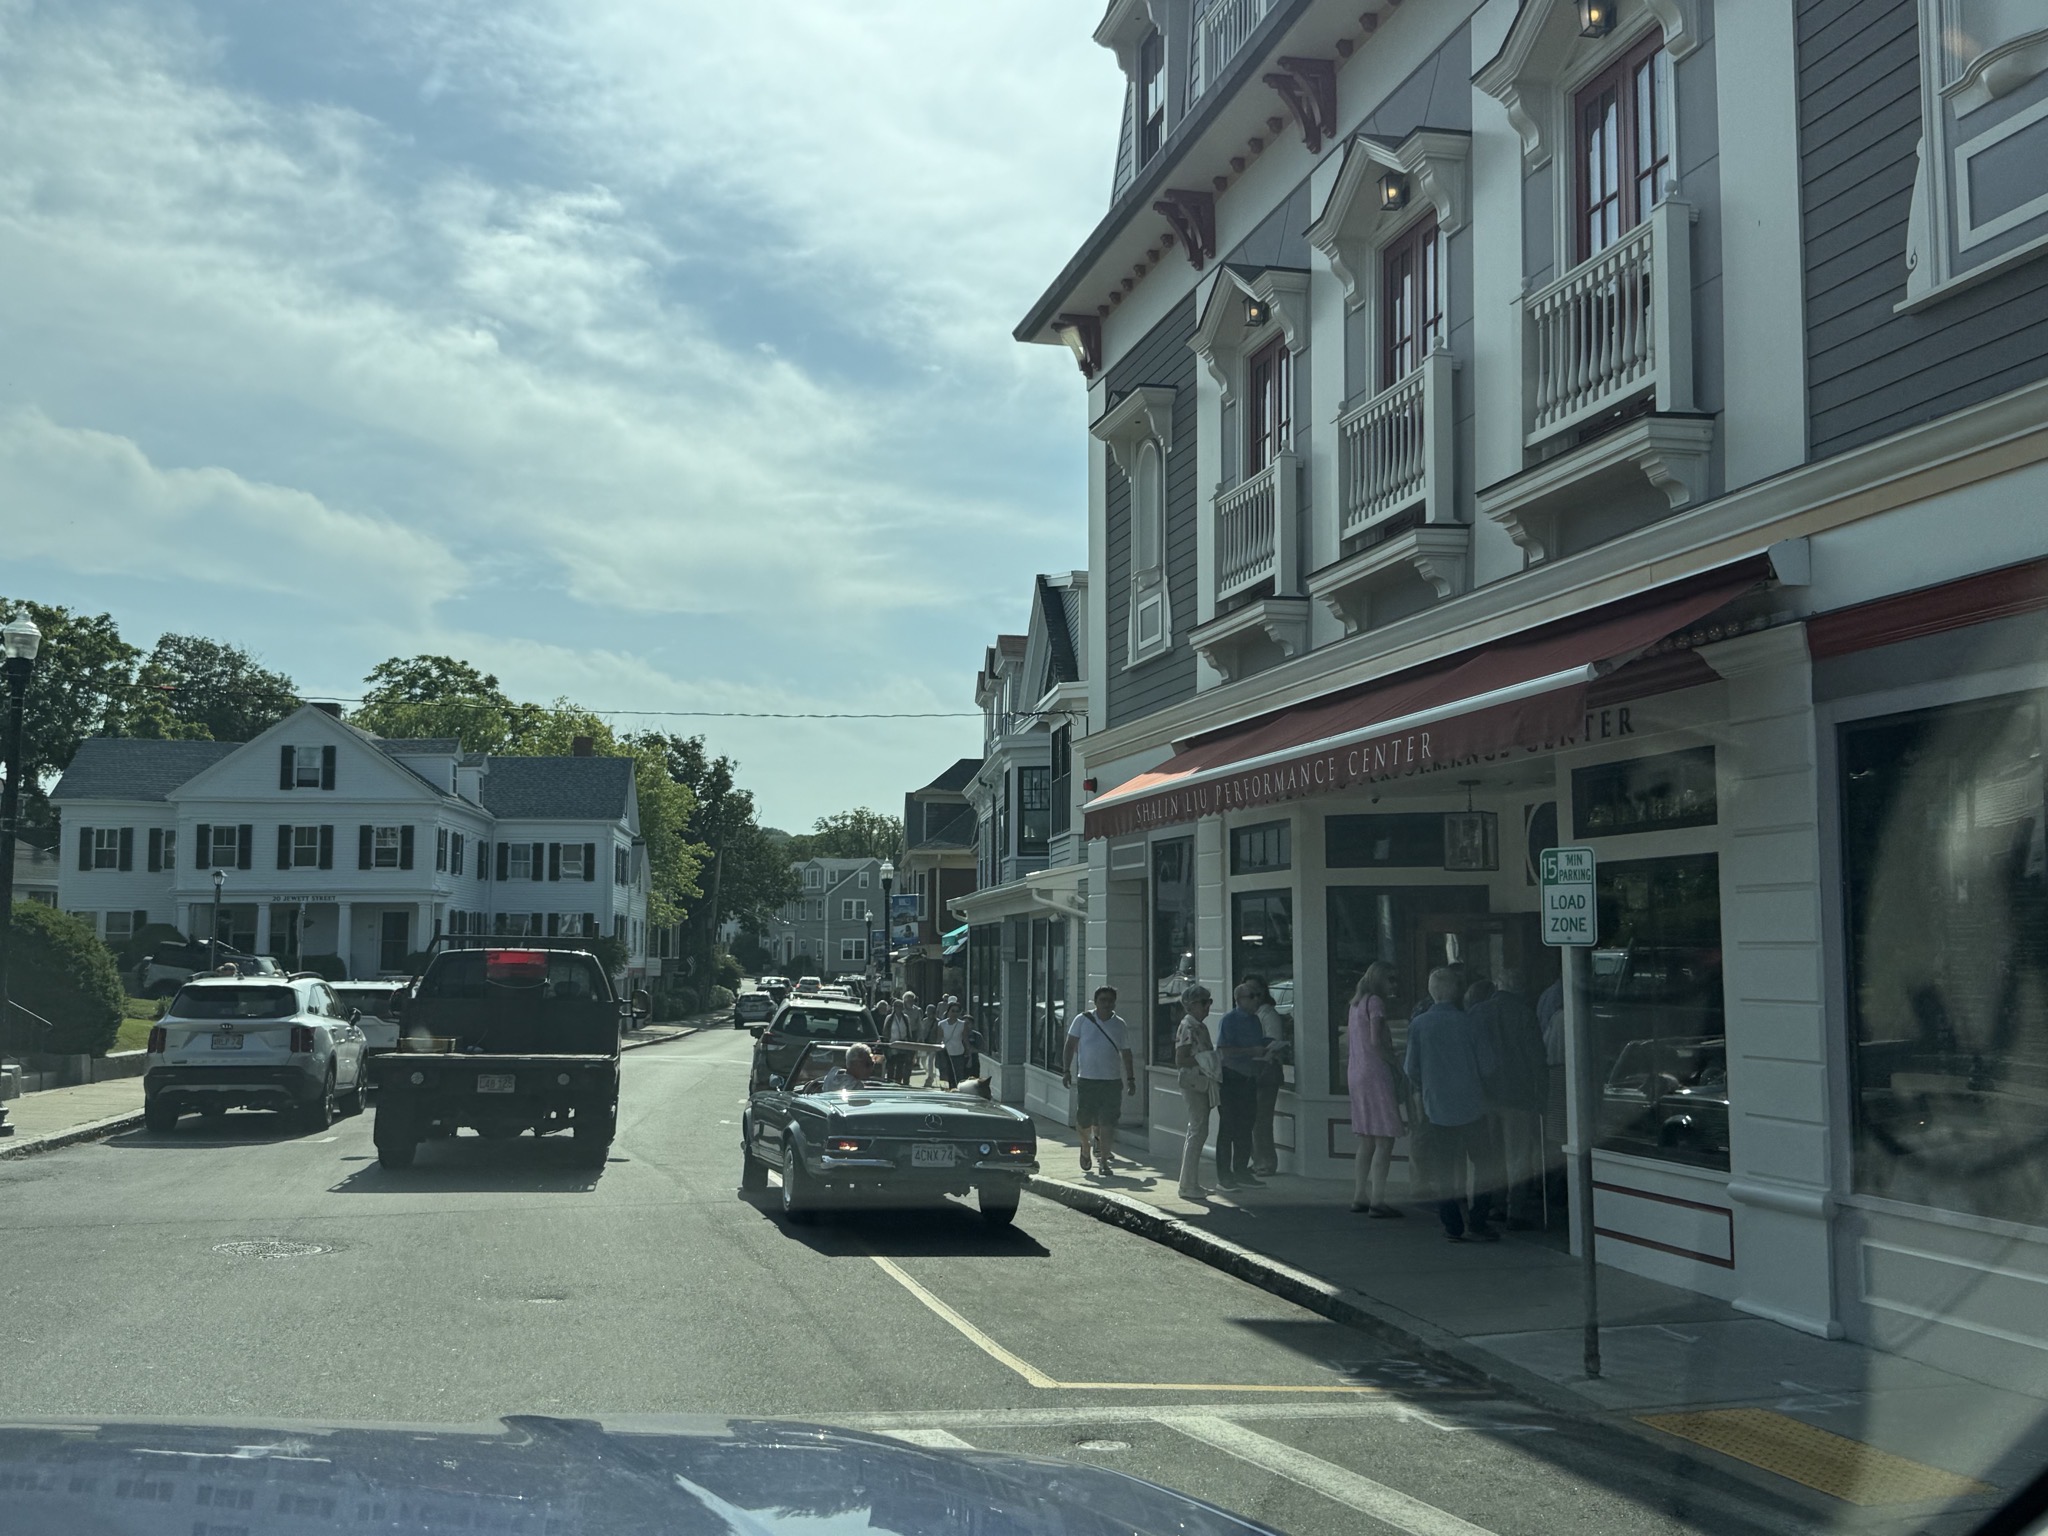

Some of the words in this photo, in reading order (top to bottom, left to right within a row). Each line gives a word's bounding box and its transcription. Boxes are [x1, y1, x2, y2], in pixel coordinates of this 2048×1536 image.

[1135, 795, 1179, 823] SHALIN
[1185, 788, 1207, 812] LIU
[1216, 757, 1335, 806] PERFORMANCE
[1348, 732, 1432, 776] CENTER
[1565, 854, 1583, 866] MIN
[1542, 857, 1557, 879] 15
[1559, 868, 1591, 881] PARKING
[1551, 895, 1586, 910] LOAD
[1551, 917, 1588, 932] ZONE
